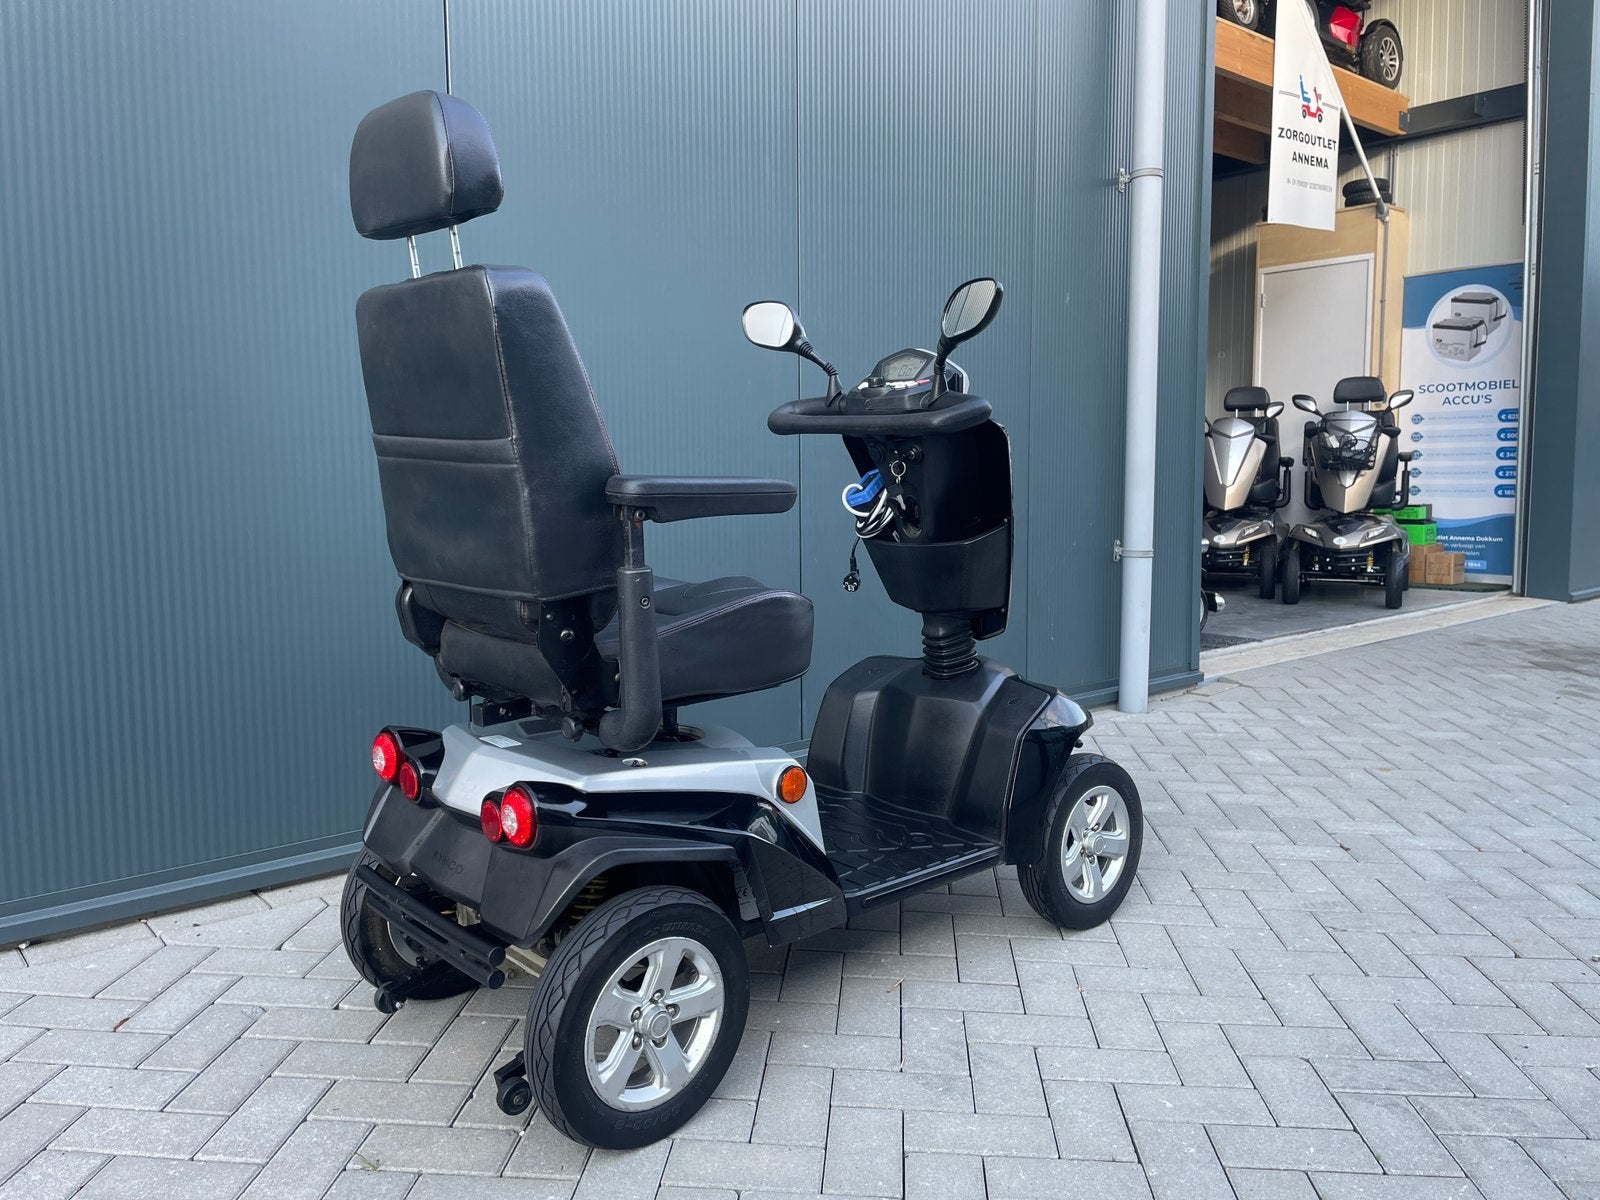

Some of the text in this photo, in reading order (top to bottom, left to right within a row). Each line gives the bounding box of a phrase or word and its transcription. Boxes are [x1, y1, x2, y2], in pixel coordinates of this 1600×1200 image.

[1277, 127, 1337, 151] ZORGOUTLET
[1292, 151, 1329, 170] ANNEMA
[1418, 379, 1520, 394] SCOOTMOBIEL
[1442, 394, 1493, 406] ACCU'S
